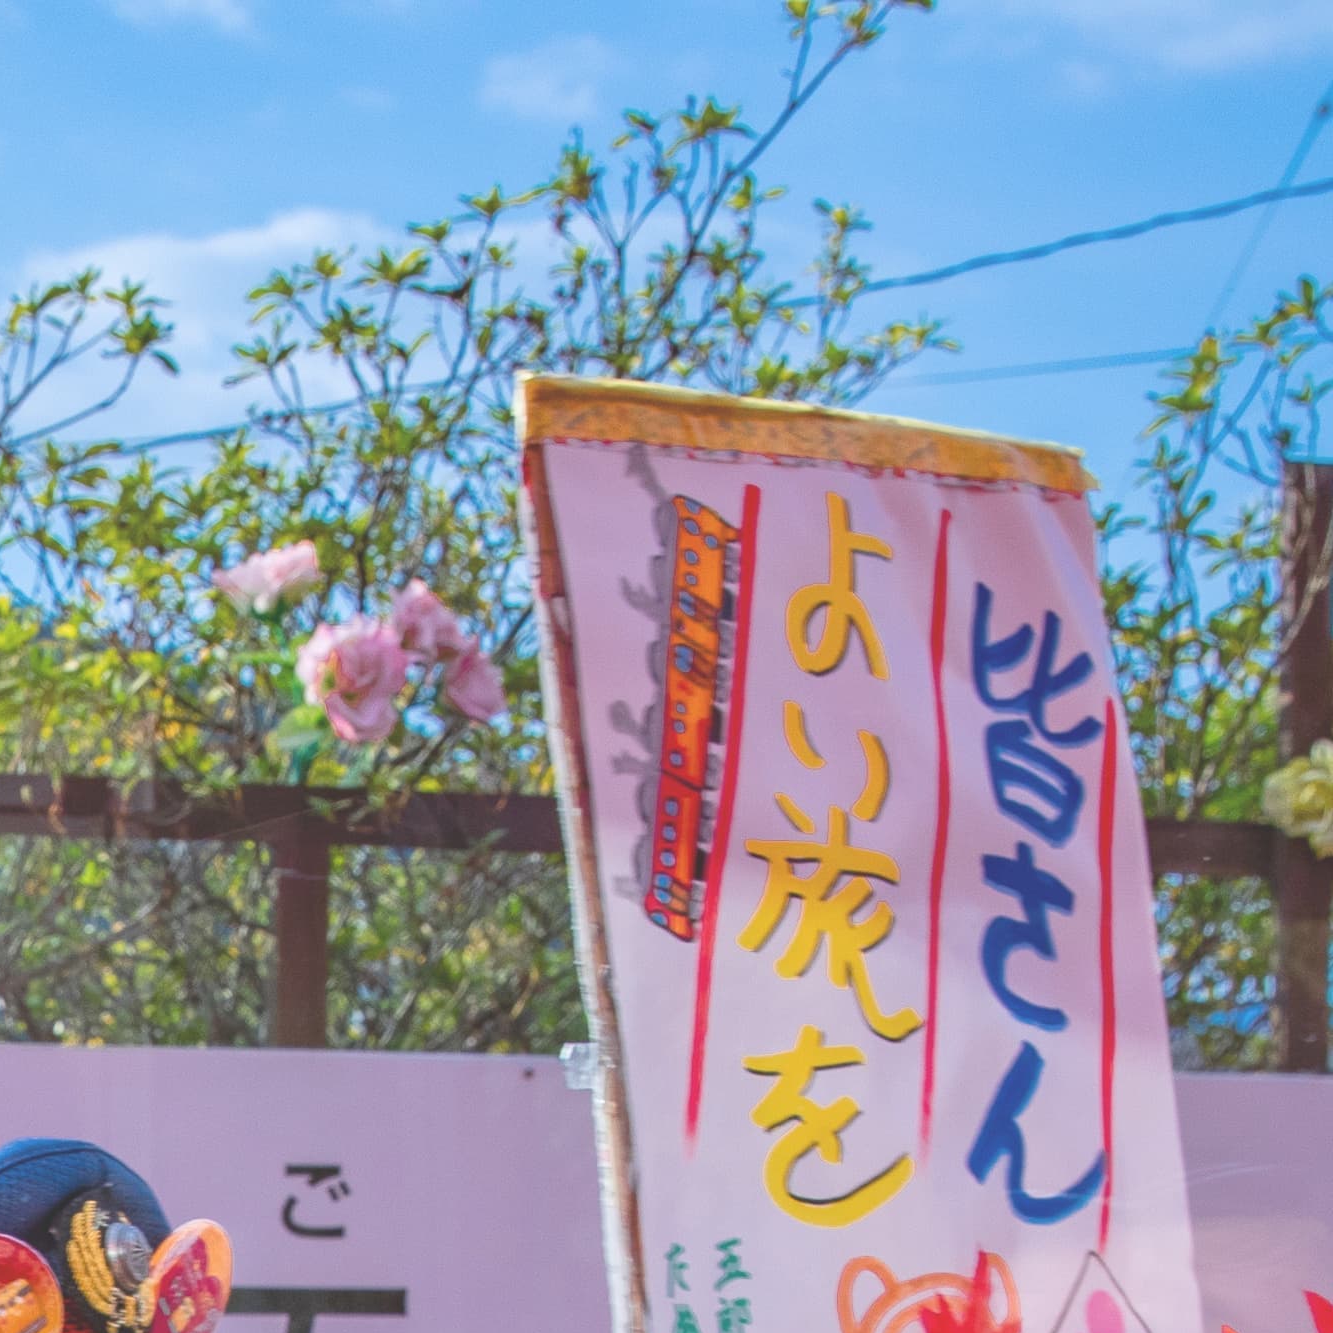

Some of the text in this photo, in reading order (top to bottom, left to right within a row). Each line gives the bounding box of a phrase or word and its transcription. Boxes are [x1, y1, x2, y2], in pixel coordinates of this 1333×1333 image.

[738, 490, 923, 1229] よい旅を
[964, 582, 1105, 1226] 皆さん
[282, 1163, 351, 1238] ご
